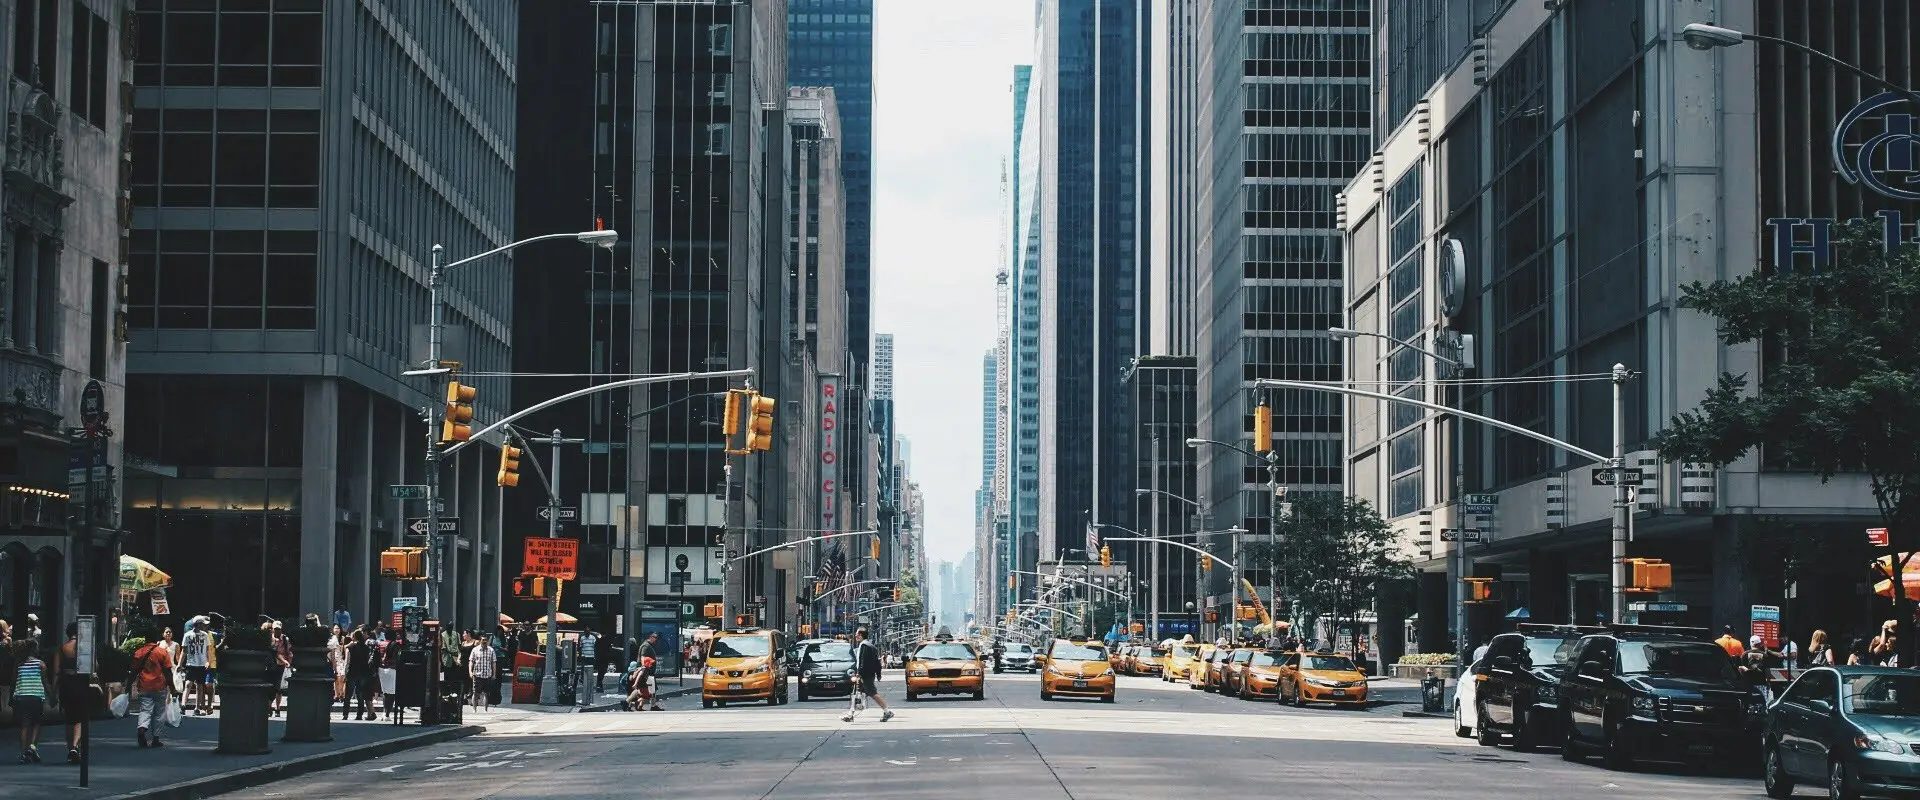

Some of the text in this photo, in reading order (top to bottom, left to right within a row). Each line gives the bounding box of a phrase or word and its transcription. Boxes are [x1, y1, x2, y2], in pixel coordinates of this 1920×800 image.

[822, 383, 836, 544] RADIO CITY
[392, 487, 399, 497] W
[400, 488, 410, 497] 54
[1481, 495, 1491, 504] 54
[554, 541, 576, 549] STREET
